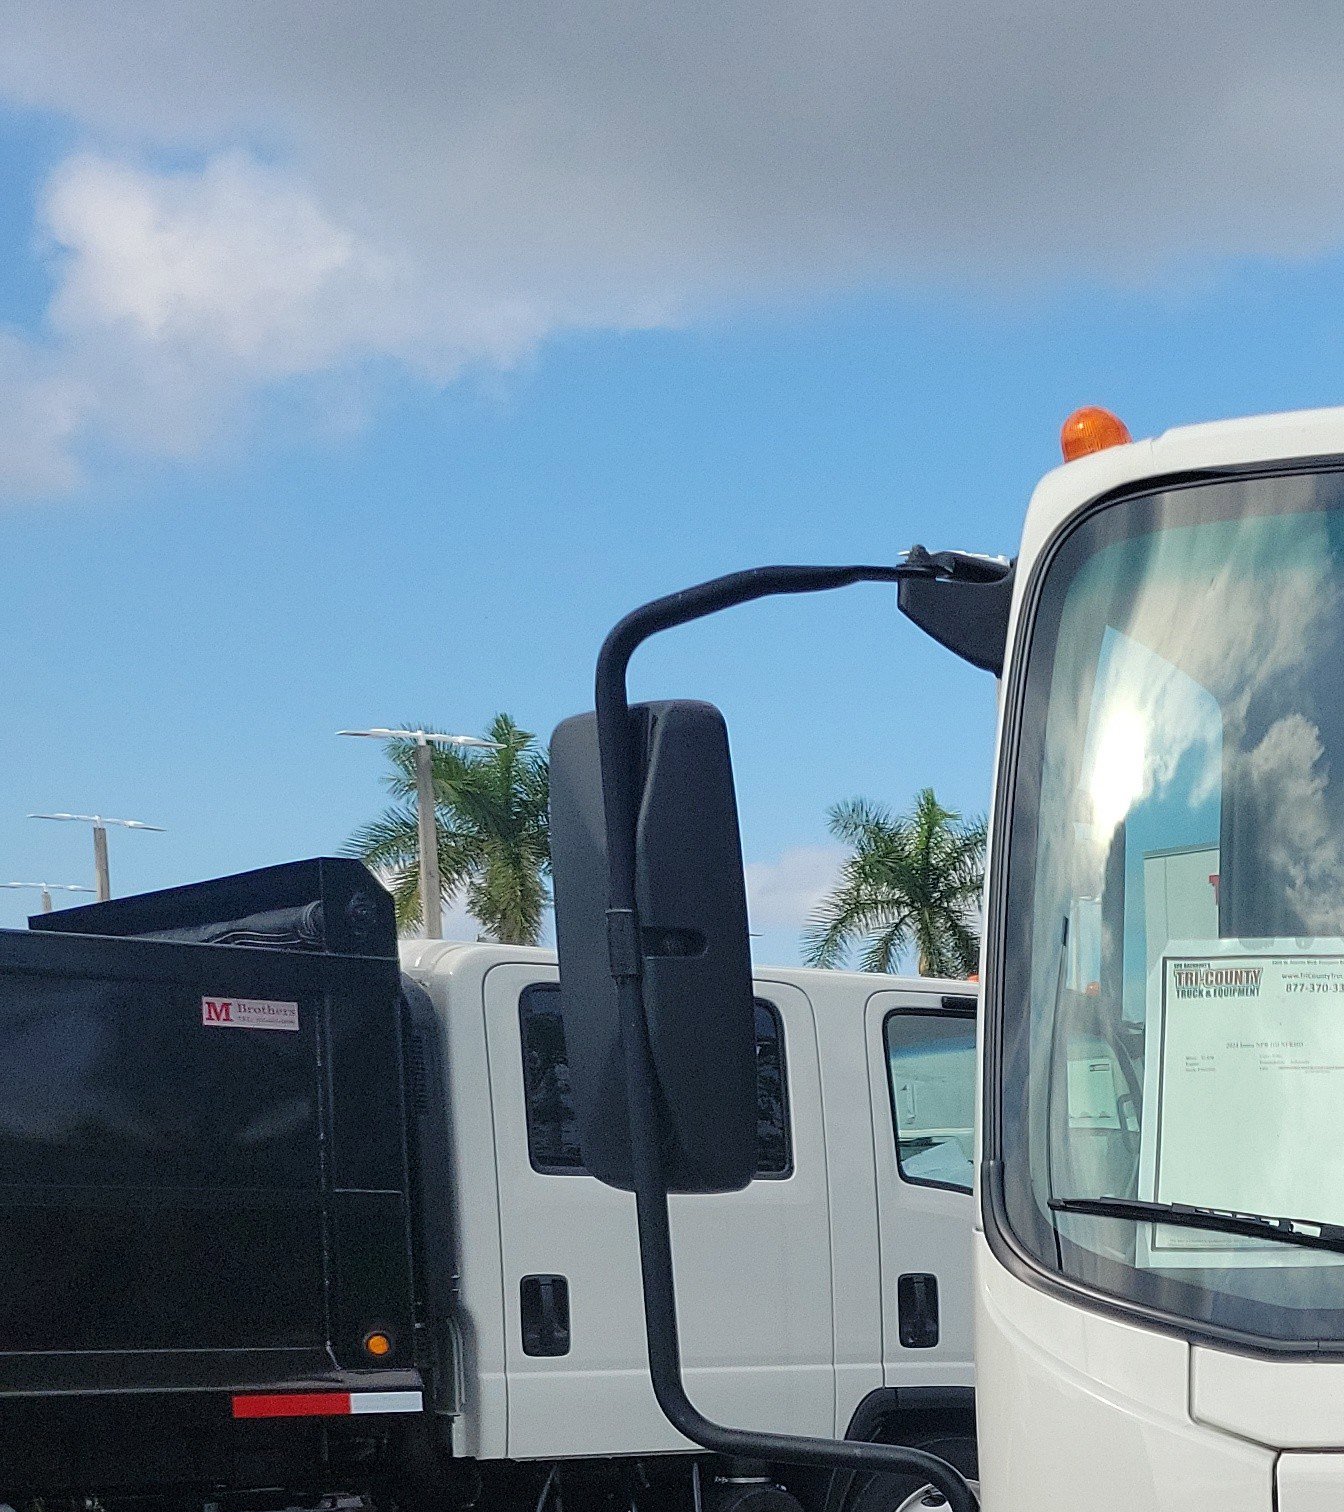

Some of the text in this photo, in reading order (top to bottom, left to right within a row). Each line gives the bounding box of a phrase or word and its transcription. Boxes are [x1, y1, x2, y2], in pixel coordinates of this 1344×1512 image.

[1175, 969, 1262, 987] TRI-COUNTY
[1177, 988, 1204, 999] TRUCK
[1213, 987, 1260, 998] EQUIPMENT
[205, 1002, 233, 1022] M
[238, 1003, 296, 1017] Brothers
